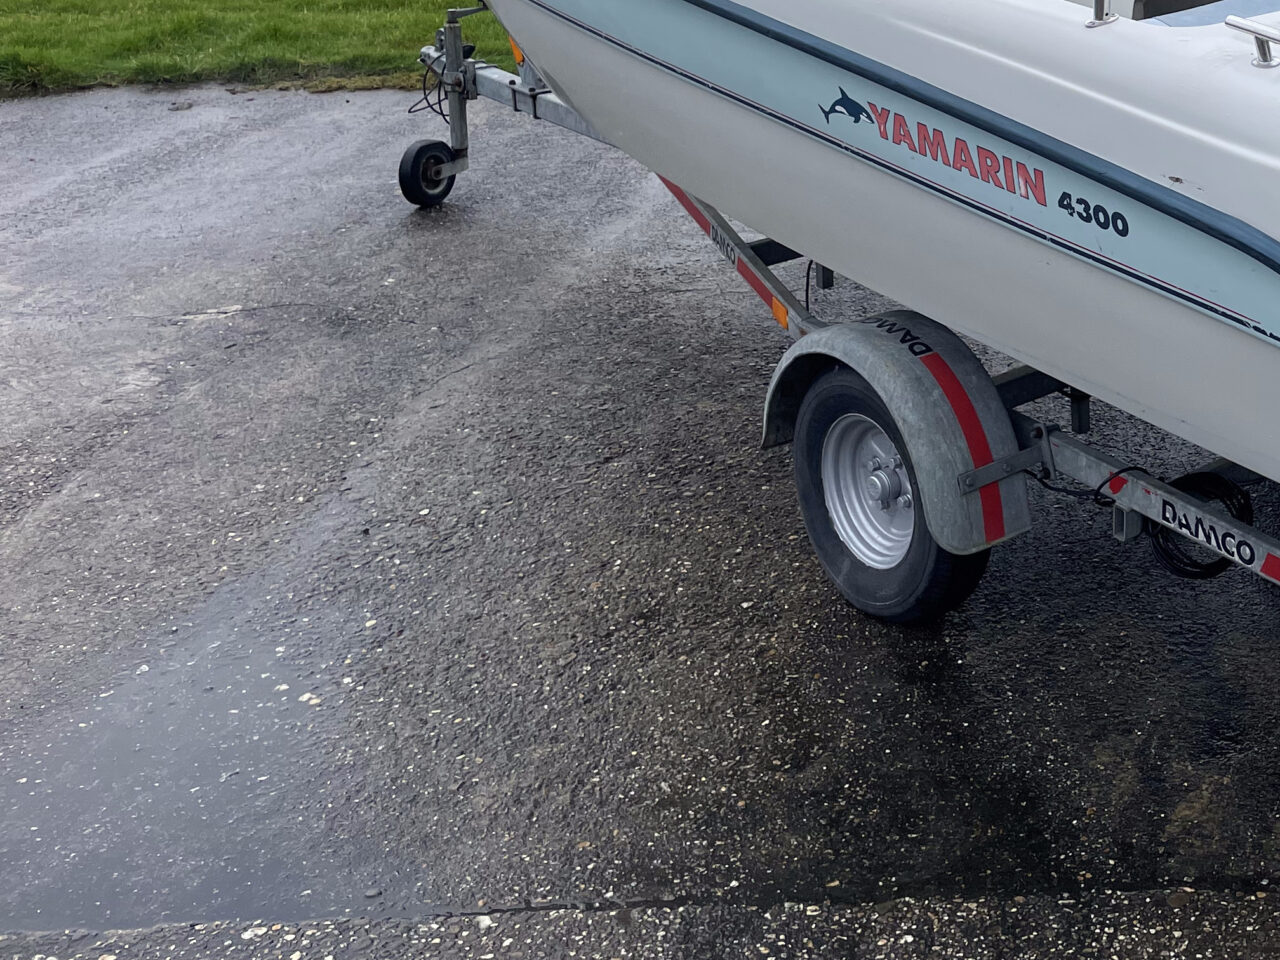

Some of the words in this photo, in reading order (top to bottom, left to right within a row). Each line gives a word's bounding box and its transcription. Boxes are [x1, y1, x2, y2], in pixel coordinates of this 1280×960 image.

[867, 102, 1047, 207] YAMARIN
[1058, 191, 1129, 238] 4300
[711, 225, 736, 265] DAMCO
[1162, 499, 1255, 567] DAMCO
